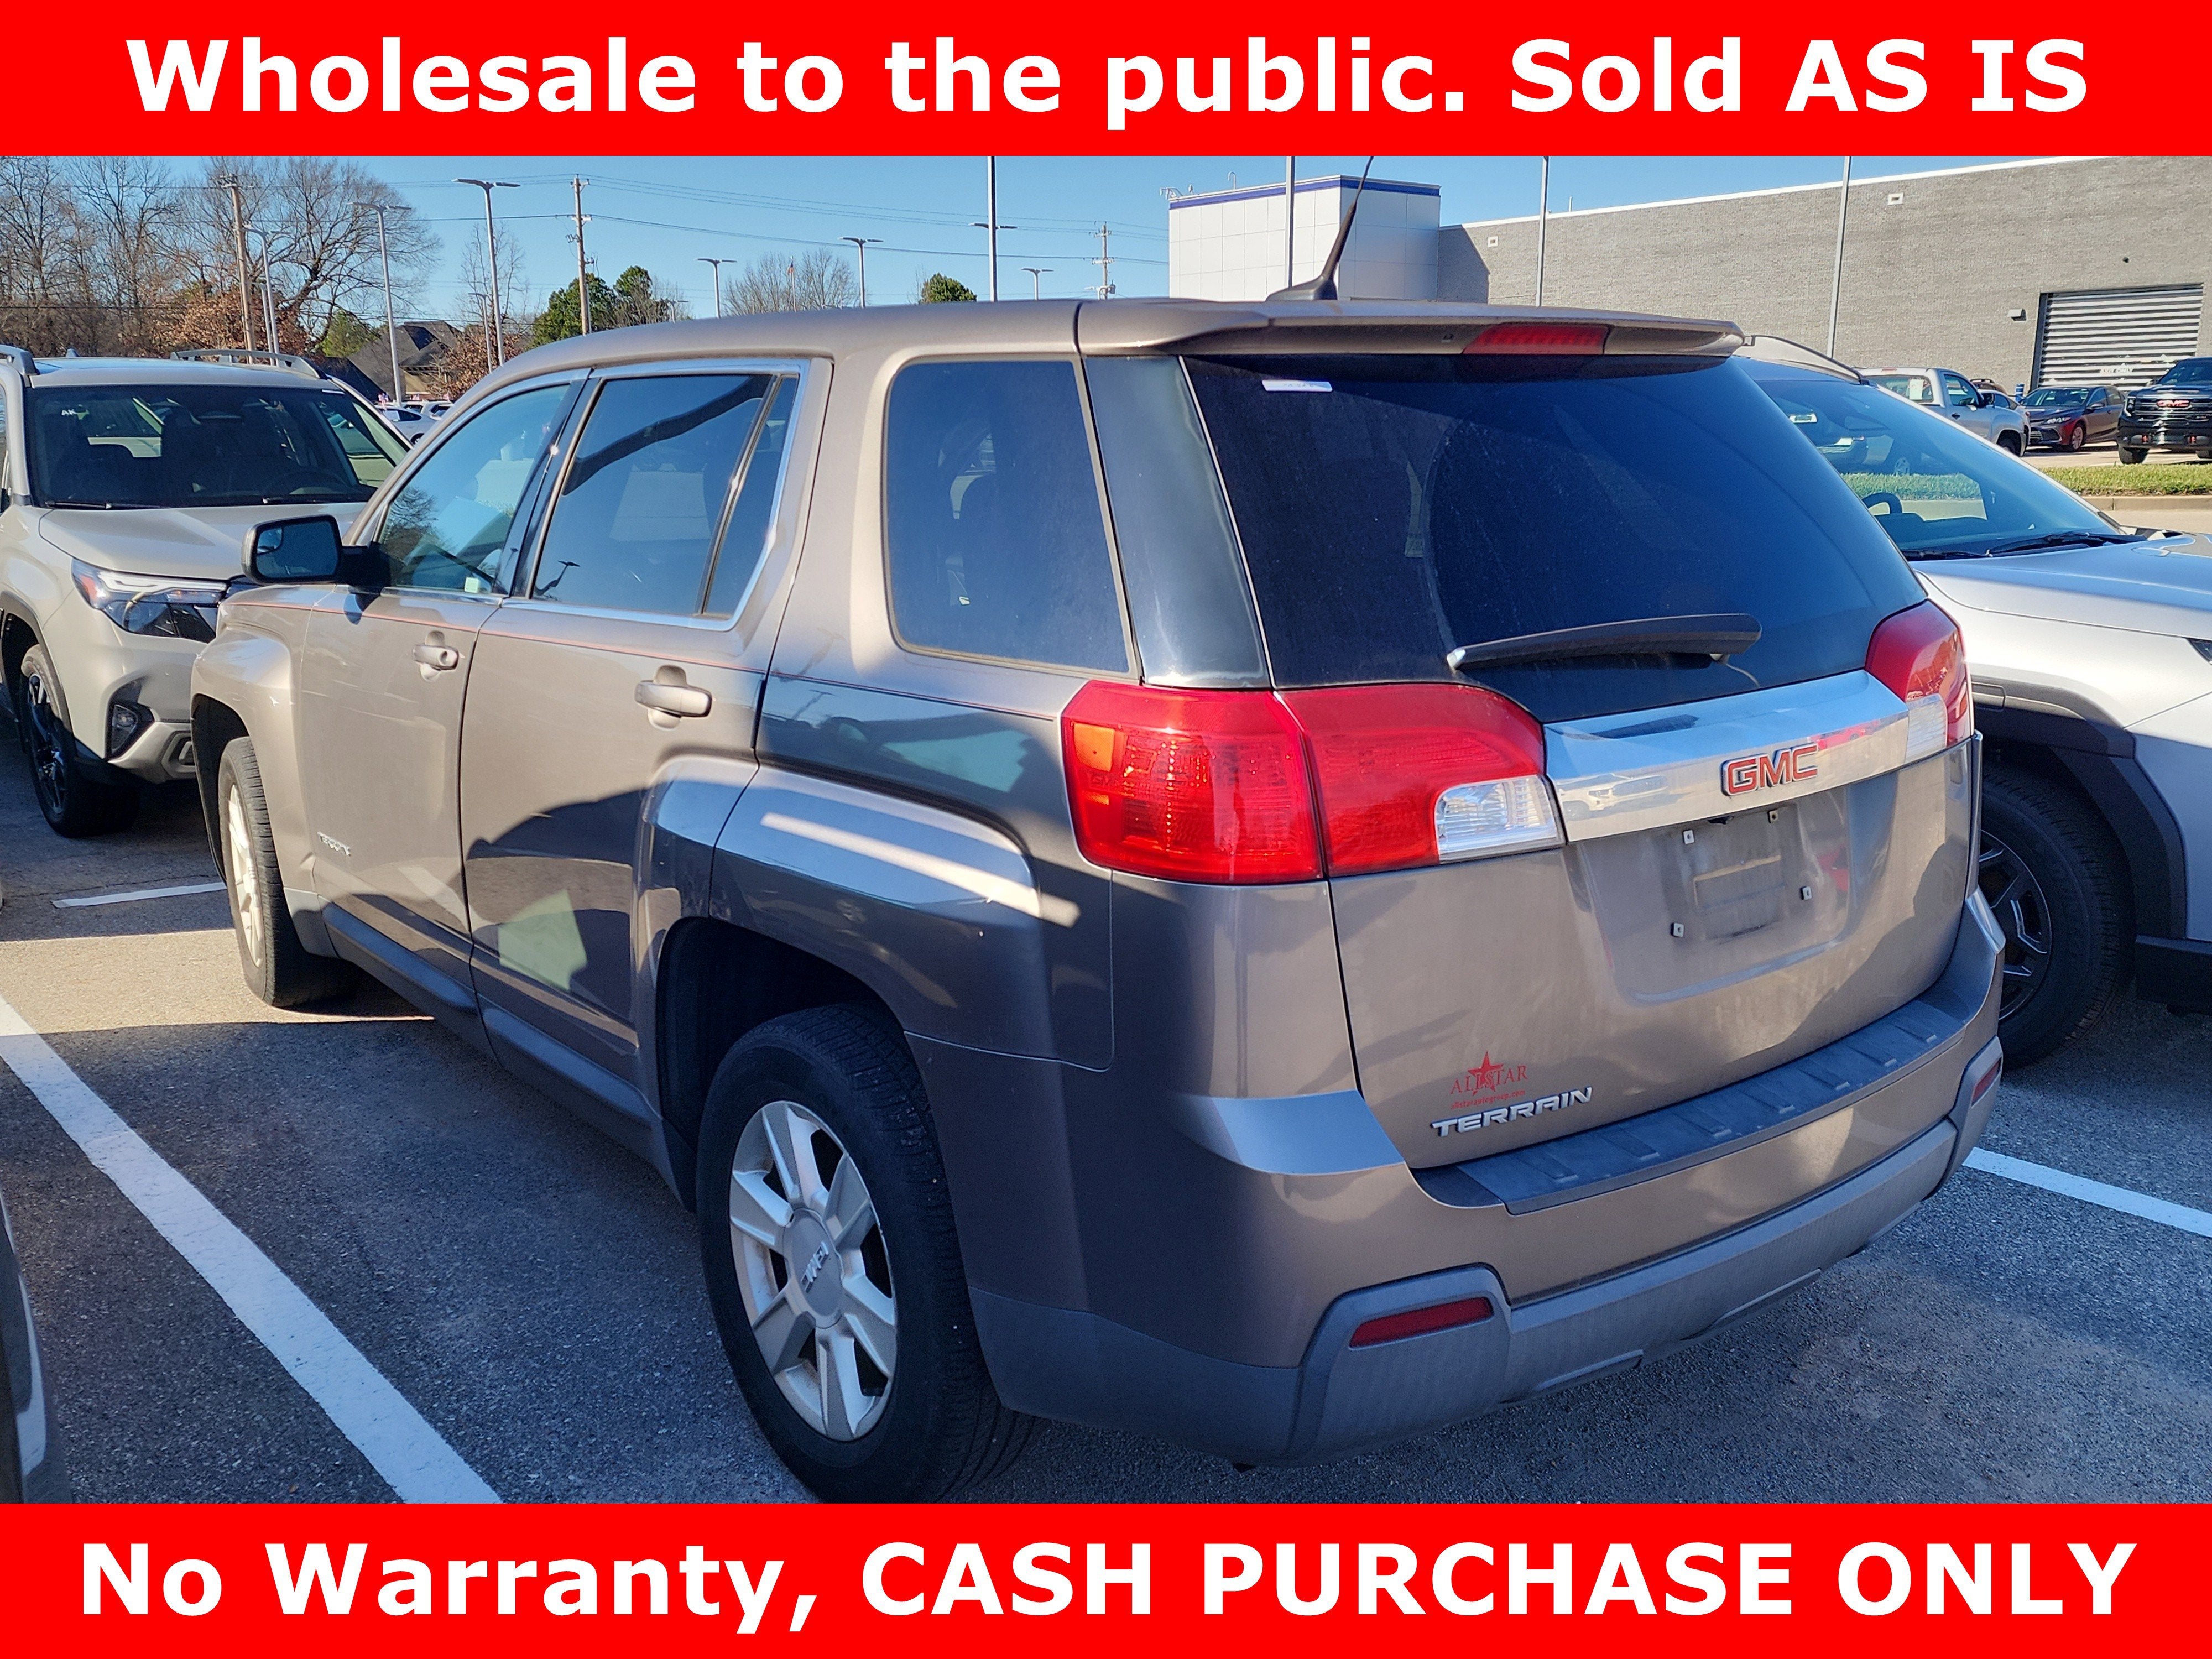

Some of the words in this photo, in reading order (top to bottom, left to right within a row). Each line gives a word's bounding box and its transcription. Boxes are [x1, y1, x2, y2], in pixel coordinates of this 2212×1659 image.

[1720, 742, 1818, 796] GMC
[1449, 1065, 1529, 1095] ALLSTAR
[1430, 1086, 1593, 1137] TERRAIN
[800, 1241, 829, 1293] GMC
